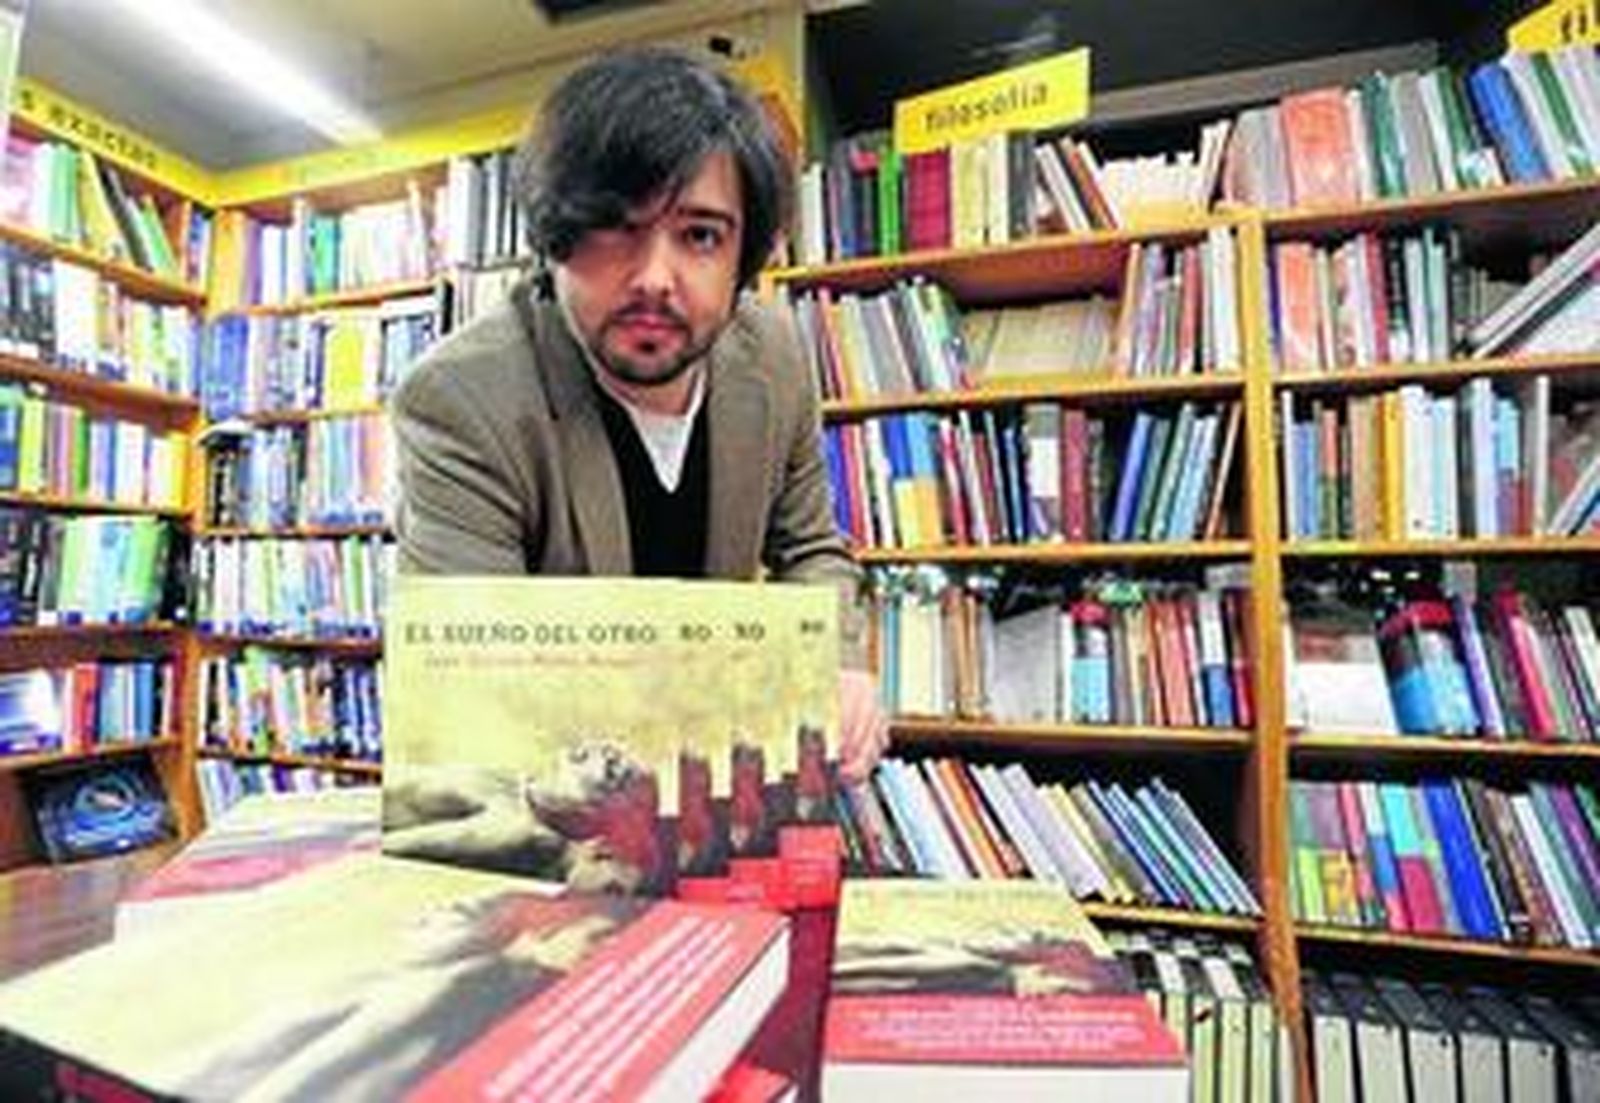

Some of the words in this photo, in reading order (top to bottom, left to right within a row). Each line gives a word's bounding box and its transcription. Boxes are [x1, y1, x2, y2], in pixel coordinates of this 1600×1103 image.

[404, 621, 433, 645] EL
[442, 619, 530, 646] SUEÑO
[534, 622, 581, 646] DEL
[586, 621, 659, 646] OTRO
